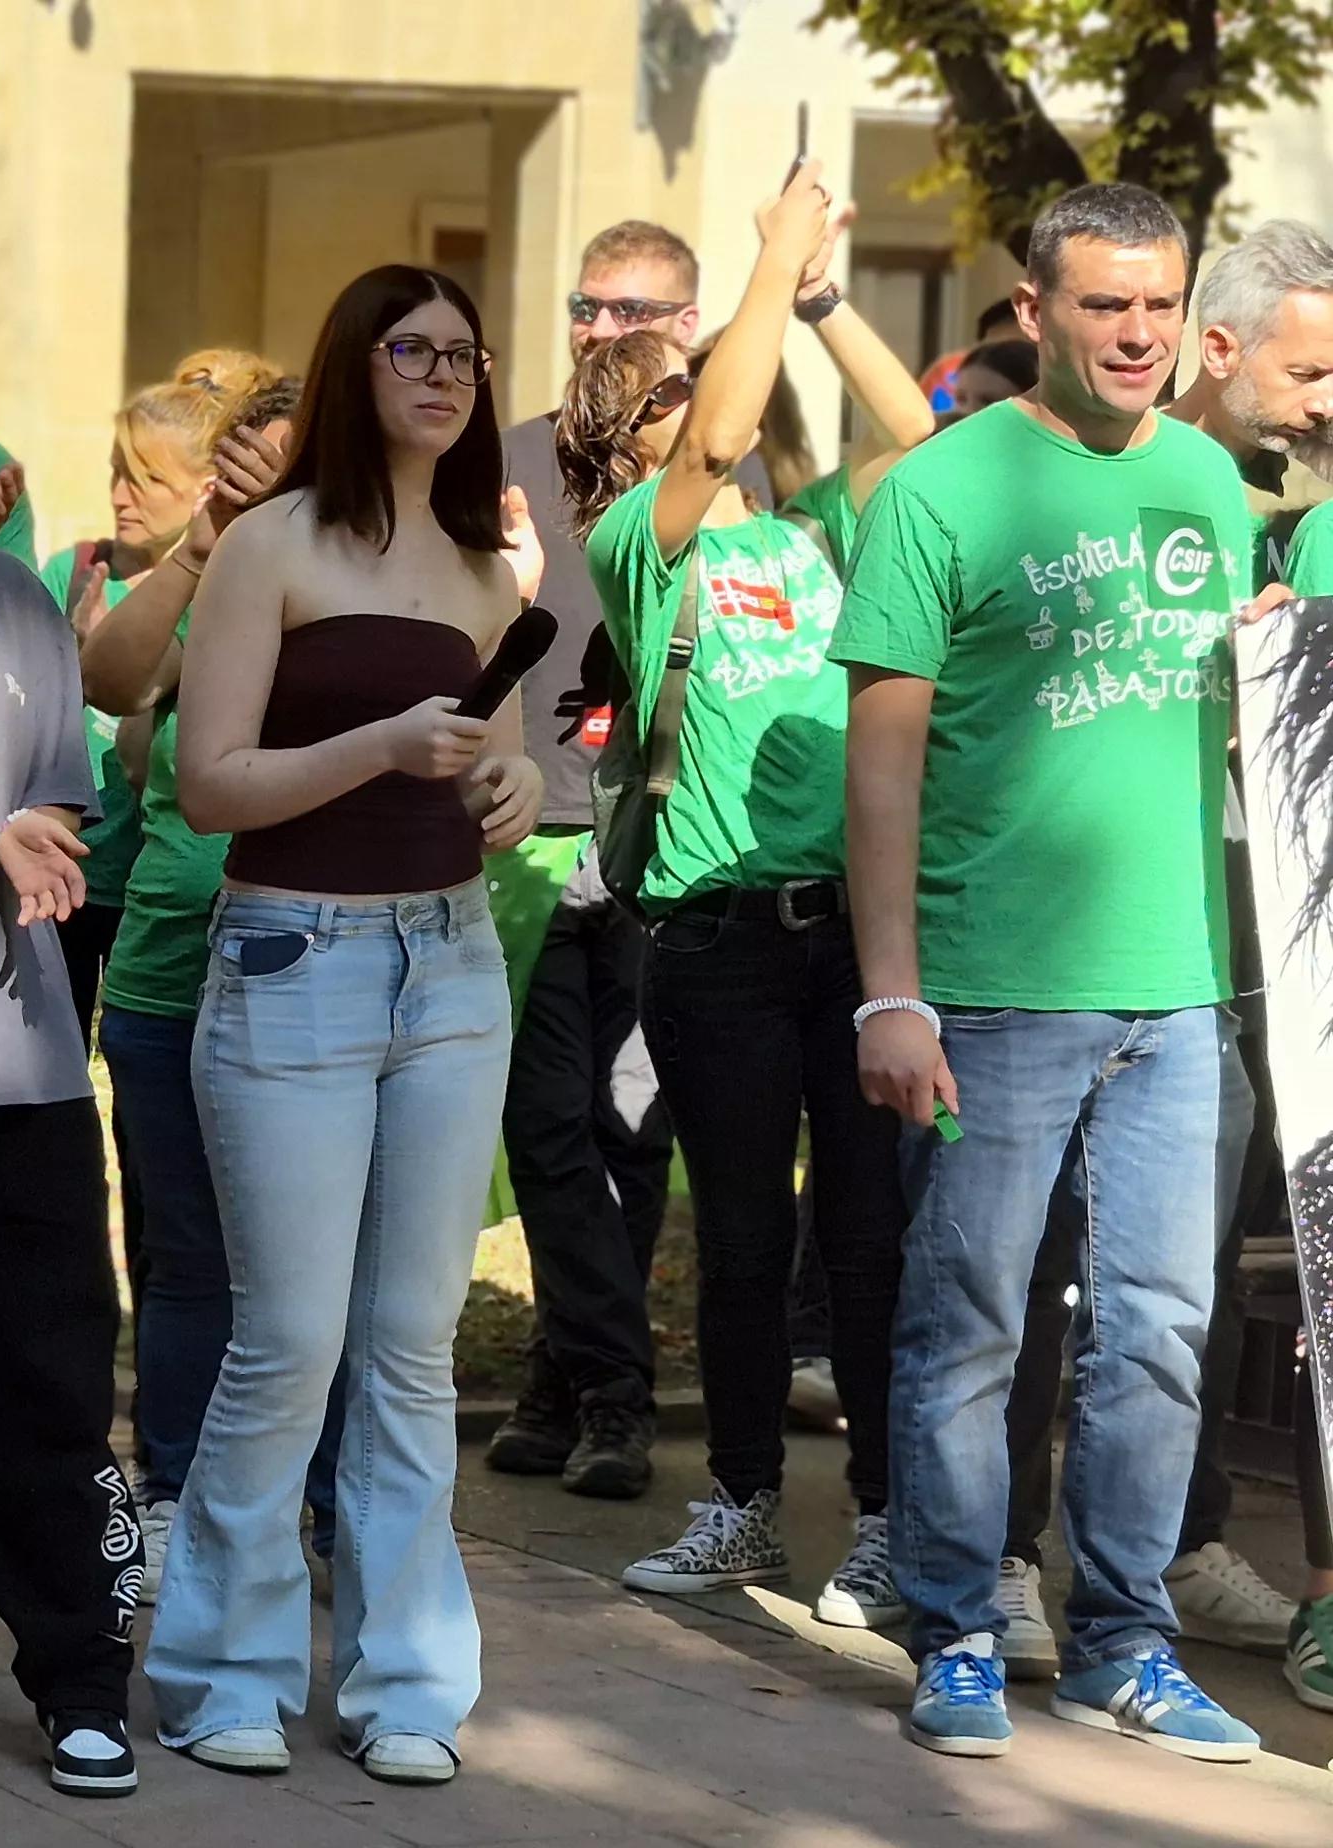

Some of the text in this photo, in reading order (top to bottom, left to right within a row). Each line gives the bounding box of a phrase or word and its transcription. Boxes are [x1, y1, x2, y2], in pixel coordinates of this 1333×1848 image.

[1023, 526, 1146, 596] ESCUELA
[1169, 546, 1214, 575] CSIF
[1070, 619, 1116, 659] DE
[1048, 668, 1148, 720] PARA
